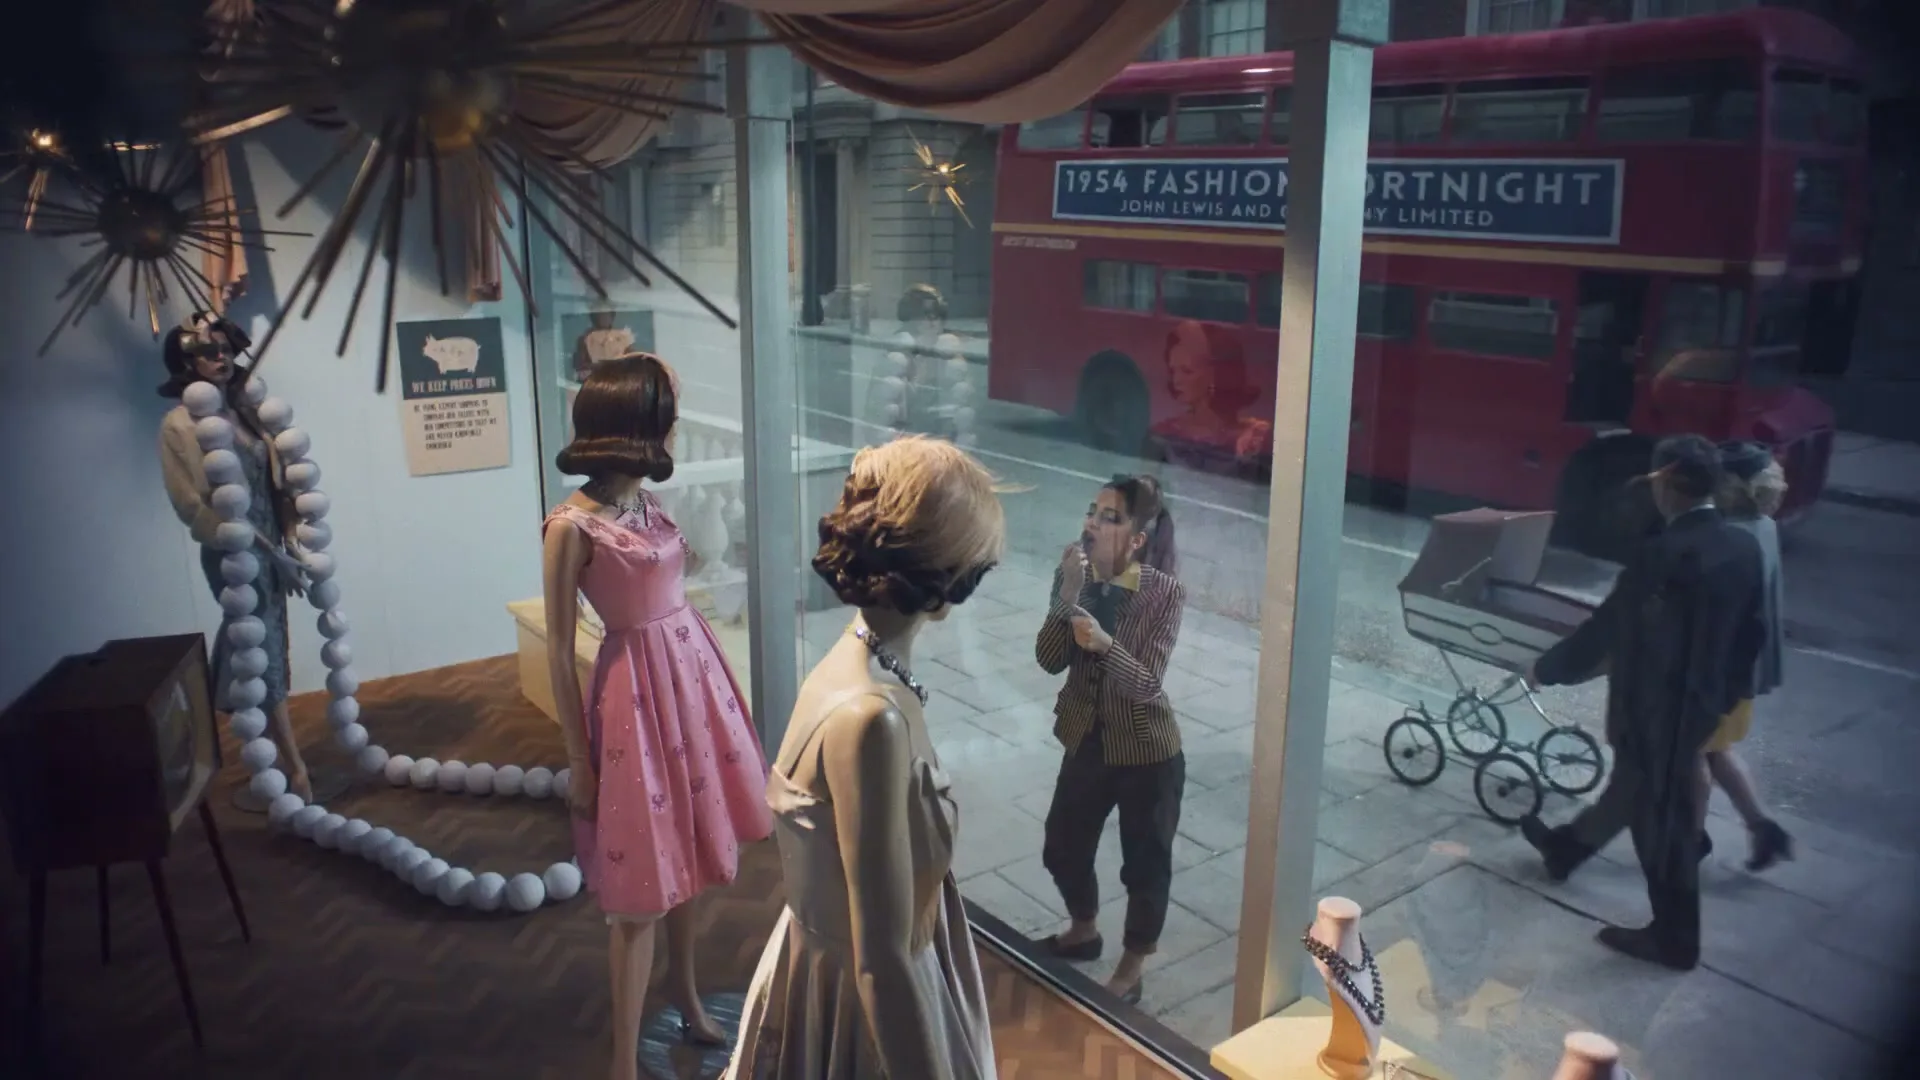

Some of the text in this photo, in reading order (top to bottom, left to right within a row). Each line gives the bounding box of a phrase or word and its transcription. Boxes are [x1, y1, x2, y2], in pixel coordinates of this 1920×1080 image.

[1066, 169, 1128, 193] 1954
[1365, 171, 1601, 204] RTNIGHT
[1120, 199, 1165, 214] JOHN
[1172, 202, 1223, 217] LEWIS
[1231, 203, 1271, 218] AND
[1398, 208, 1493, 226] LIMITED
